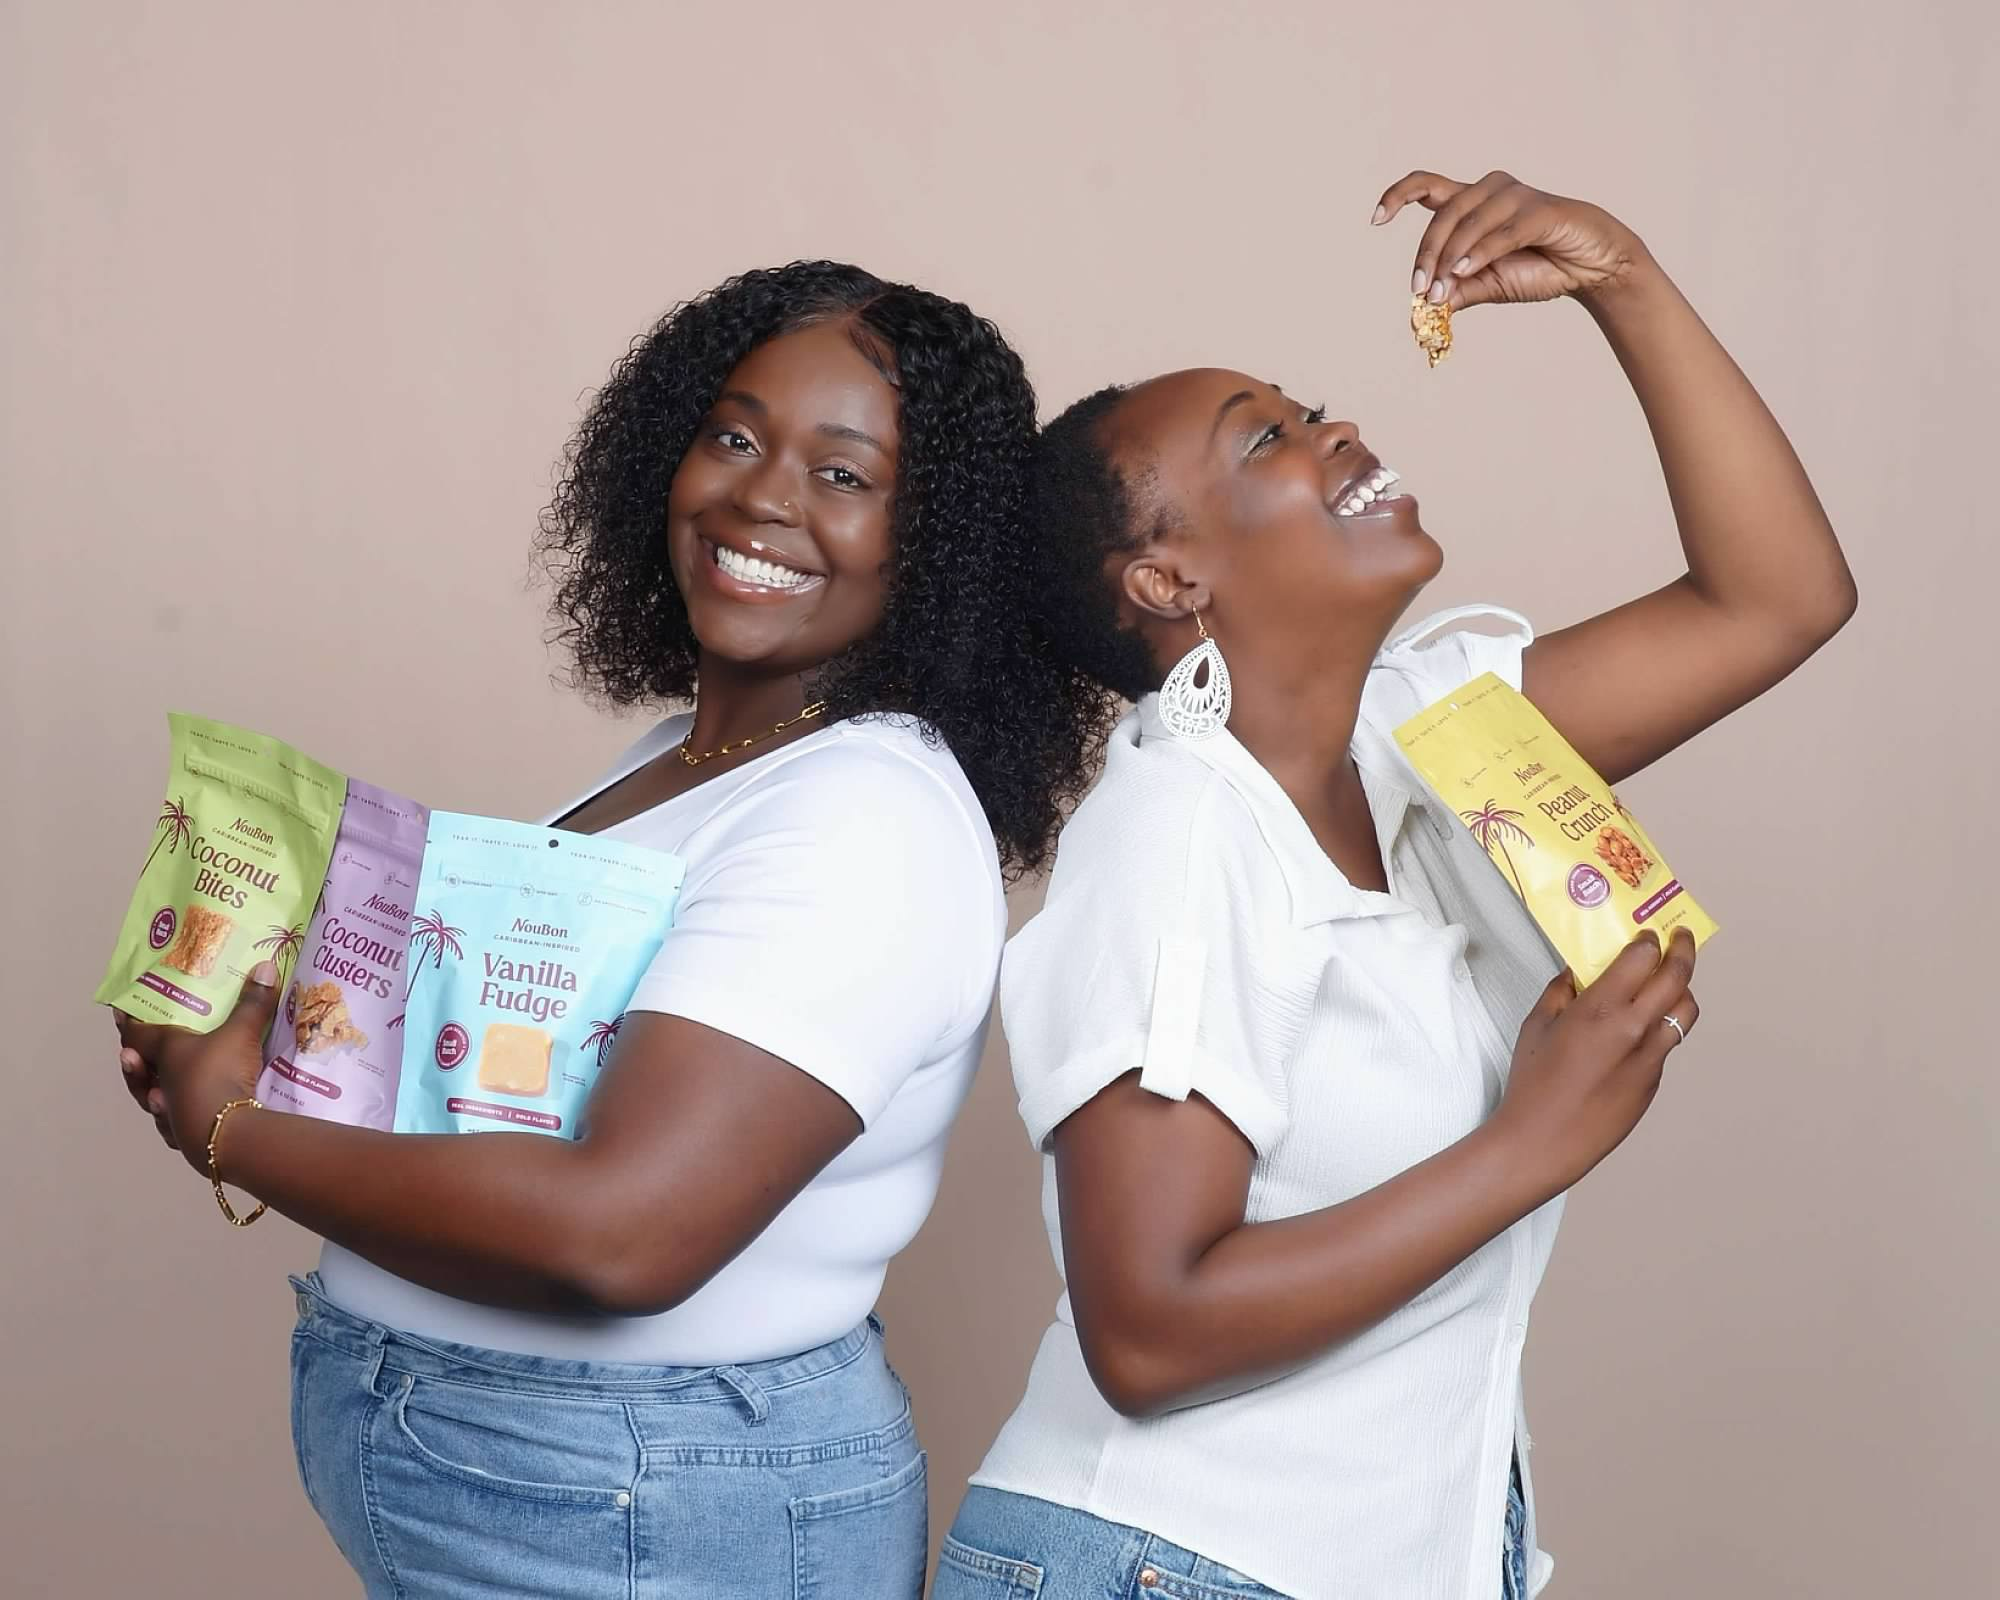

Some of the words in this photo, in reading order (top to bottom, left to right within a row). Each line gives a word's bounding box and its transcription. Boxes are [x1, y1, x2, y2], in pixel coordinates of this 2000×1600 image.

[1537, 784, 1591, 822] Peanut
[1560, 801, 1614, 841] Crunch
[228, 818, 274, 845] NouBon
[191, 836, 280, 894] Coconut
[194, 868, 248, 908] Bites
[362, 893, 409, 920] NouBon
[322, 918, 404, 972] Coconut
[494, 934, 580, 952] CARIBBEAN-INSPIRED
[512, 918, 568, 938] NouBon
[313, 945, 392, 998] Clusters
[484, 952, 577, 992] Vanilla
[479, 981, 567, 1022] Fudge
